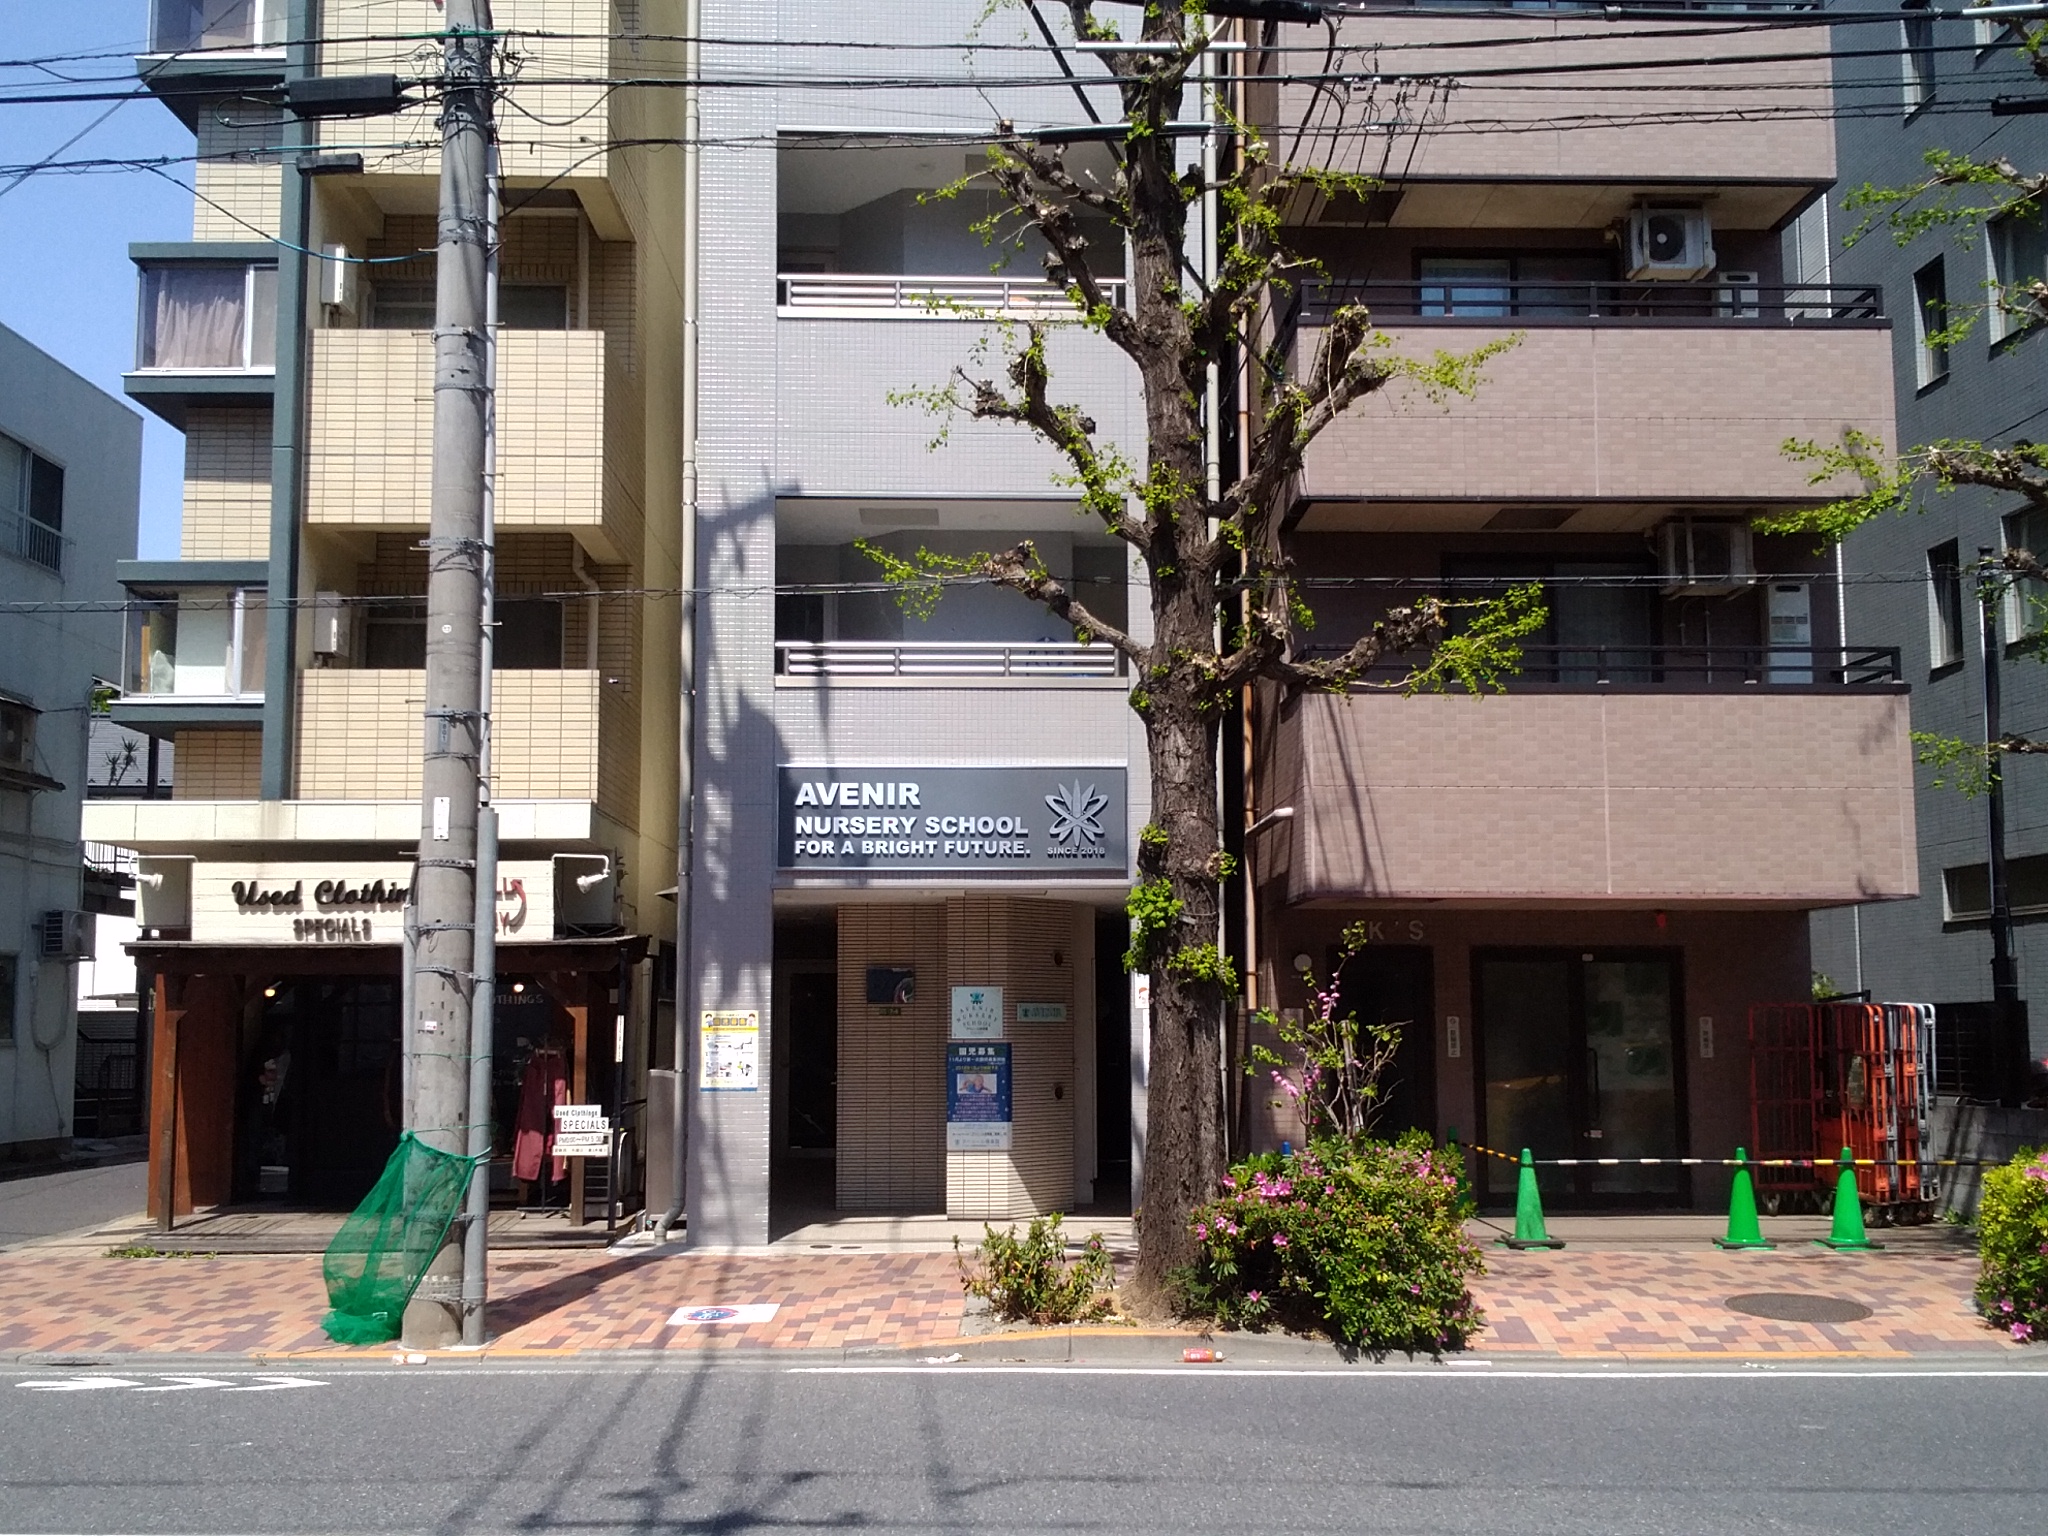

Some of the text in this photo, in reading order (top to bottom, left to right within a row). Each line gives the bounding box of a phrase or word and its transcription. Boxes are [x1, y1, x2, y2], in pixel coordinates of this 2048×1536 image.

[795, 782, 921, 806] AVENIR
[795, 816, 1029, 834] NURSERY SCHOOL
[795, 841, 1031, 854] FOR A BRIGHT FUTURE.
[1047, 847, 1106, 855] SINCE 2018
[231, 879, 408, 906] Used Clothin
[293, 918, 372, 940] SPECIALS
[493, 994, 545, 1005] THINGS
[563, 1119, 607, 1130] SPECIALS
